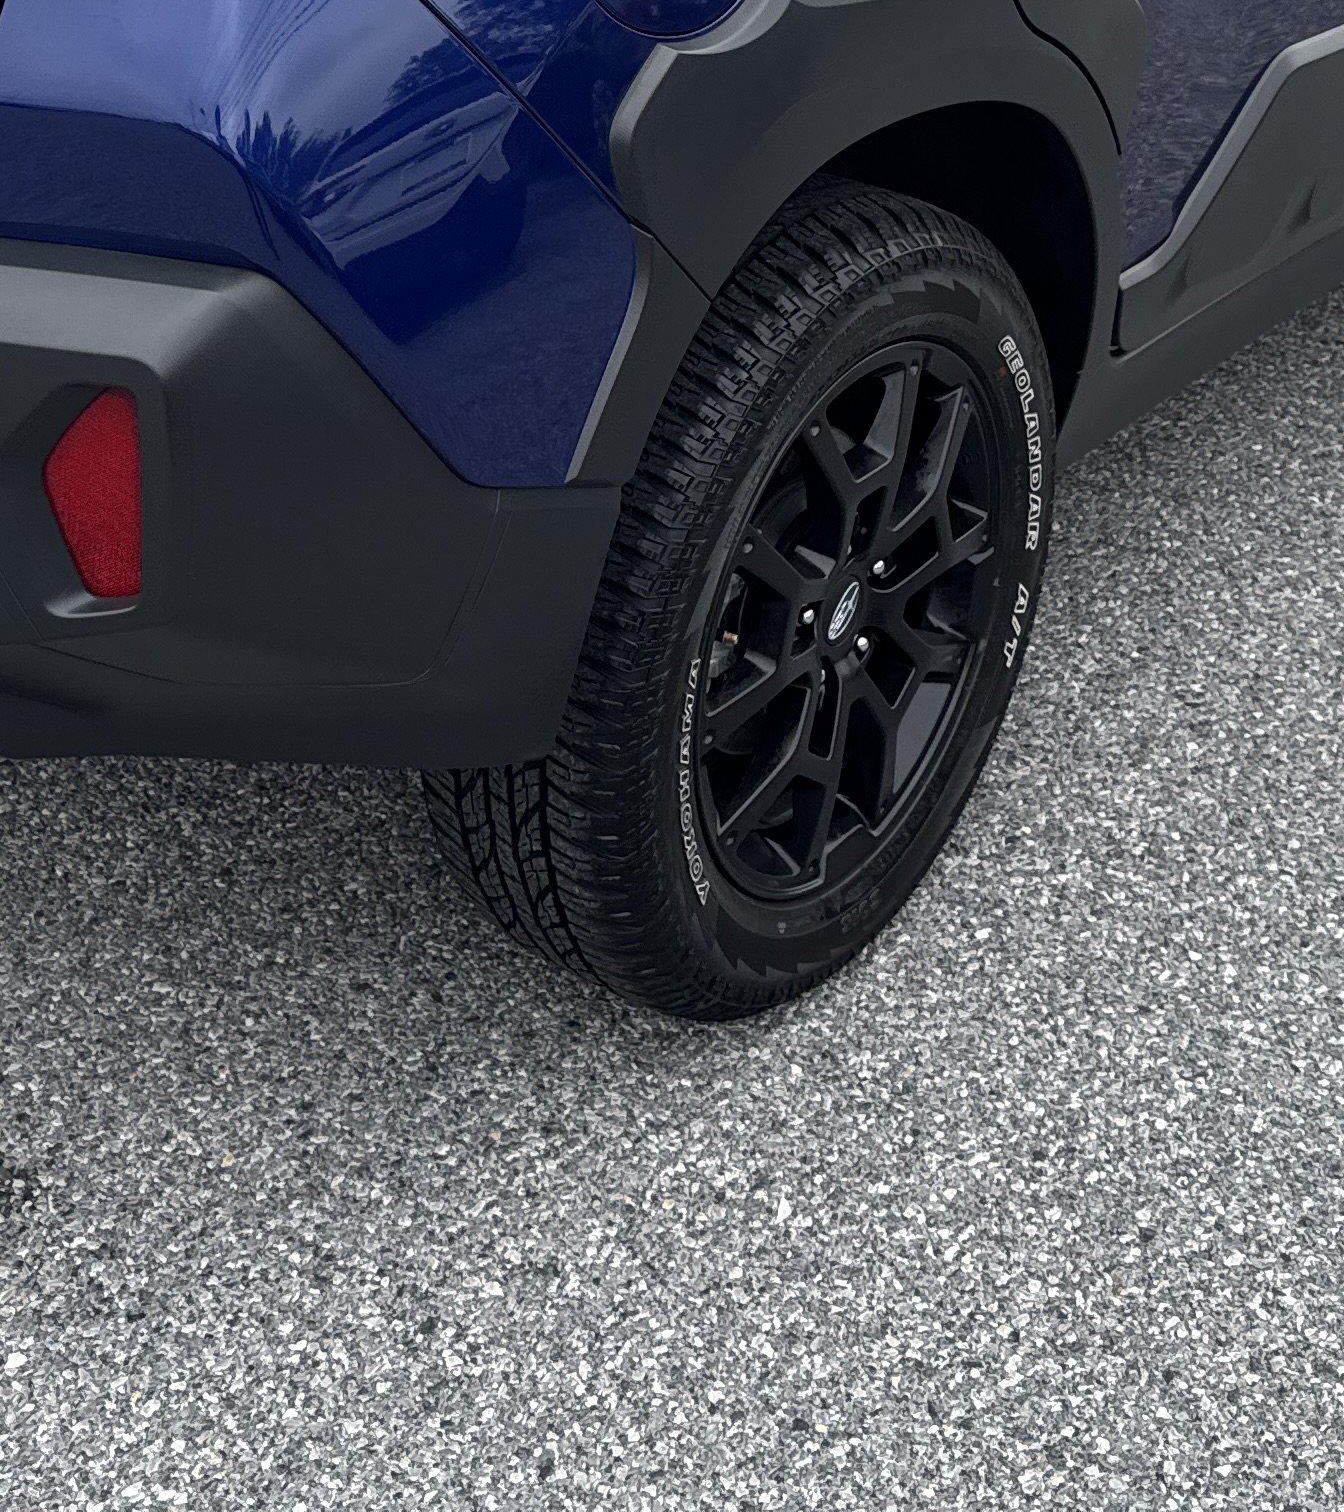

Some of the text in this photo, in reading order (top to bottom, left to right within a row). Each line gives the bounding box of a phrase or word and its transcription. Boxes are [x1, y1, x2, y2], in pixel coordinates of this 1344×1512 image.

[998, 335, 1042, 669] GEOLANDAR A/T
[679, 657, 711, 906] YOKOHAMA
